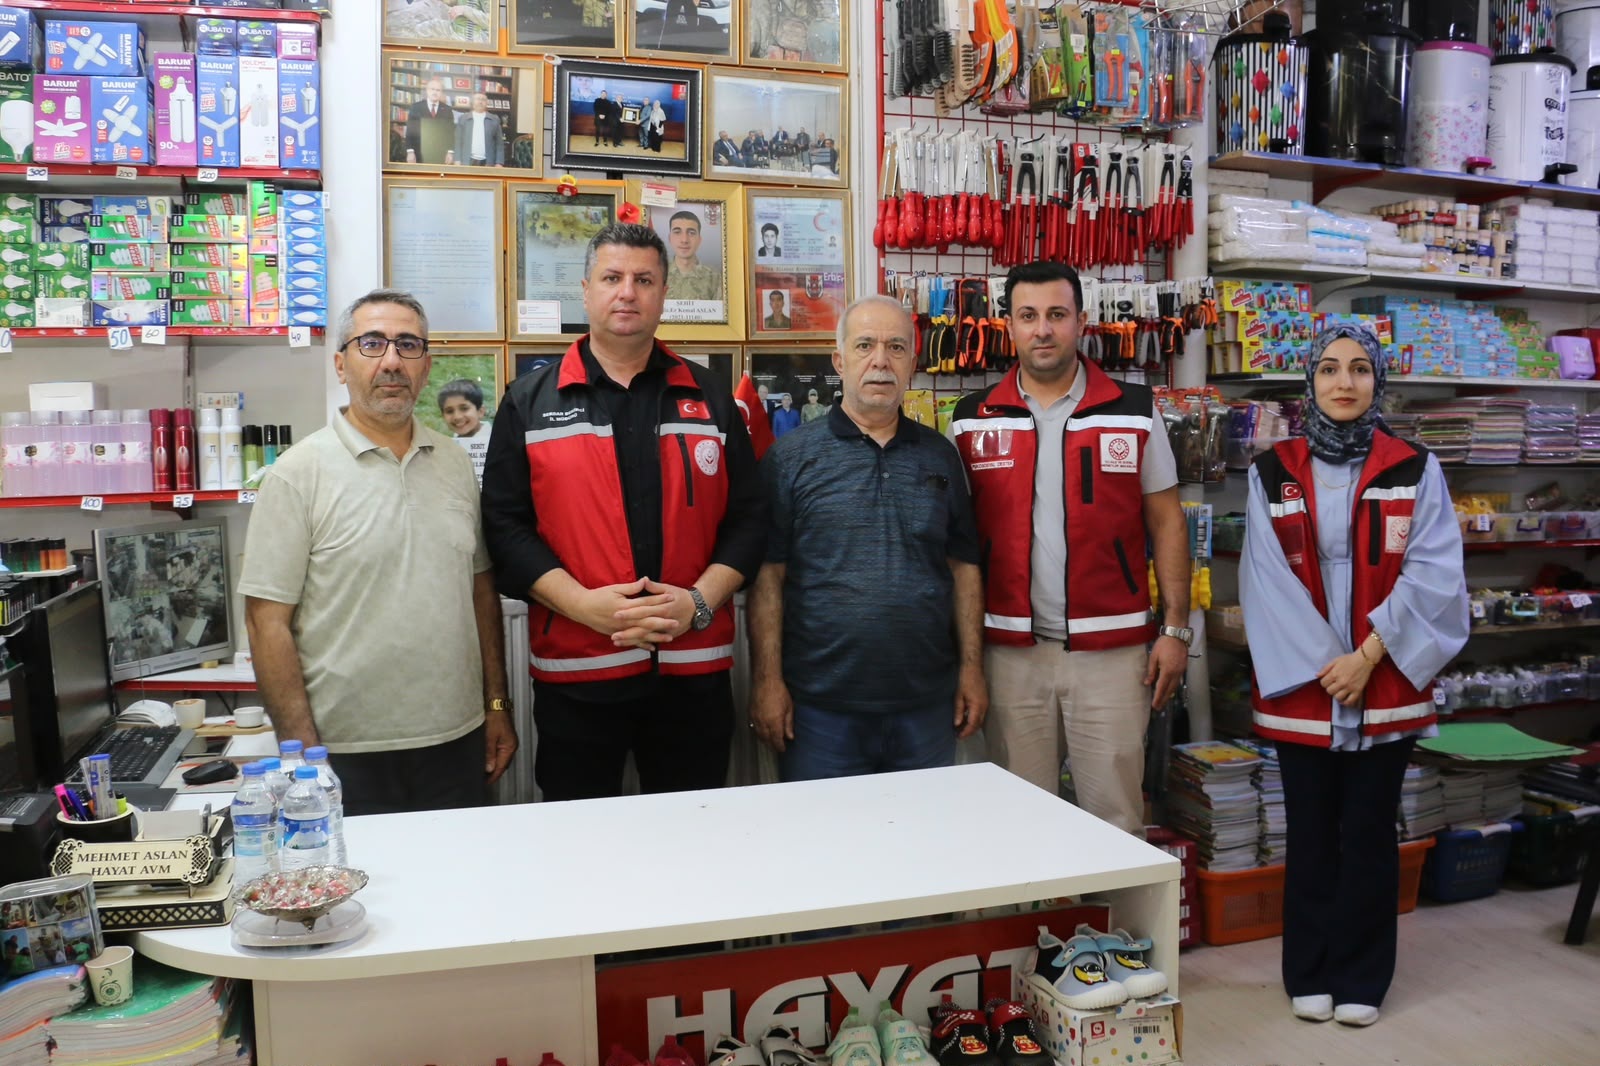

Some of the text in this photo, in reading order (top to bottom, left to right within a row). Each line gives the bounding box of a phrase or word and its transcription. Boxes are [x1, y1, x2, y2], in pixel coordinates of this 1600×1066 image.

[124, 33, 132, 65] BARUM
[158, 58, 191, 66] BARUM
[200, 61, 233, 70] BARUM
[281, 63, 313, 71] BARUM
[43, 80, 77, 88] BARUM
[102, 81, 136, 89] BARUM
[28, 168, 46, 177] 300
[200, 171, 216, 179] 200
[111, 329, 129, 348] 50
[77, 850, 188, 862] MEHMET ASLAN
[91, 864, 171, 876] HAYAT AVM
